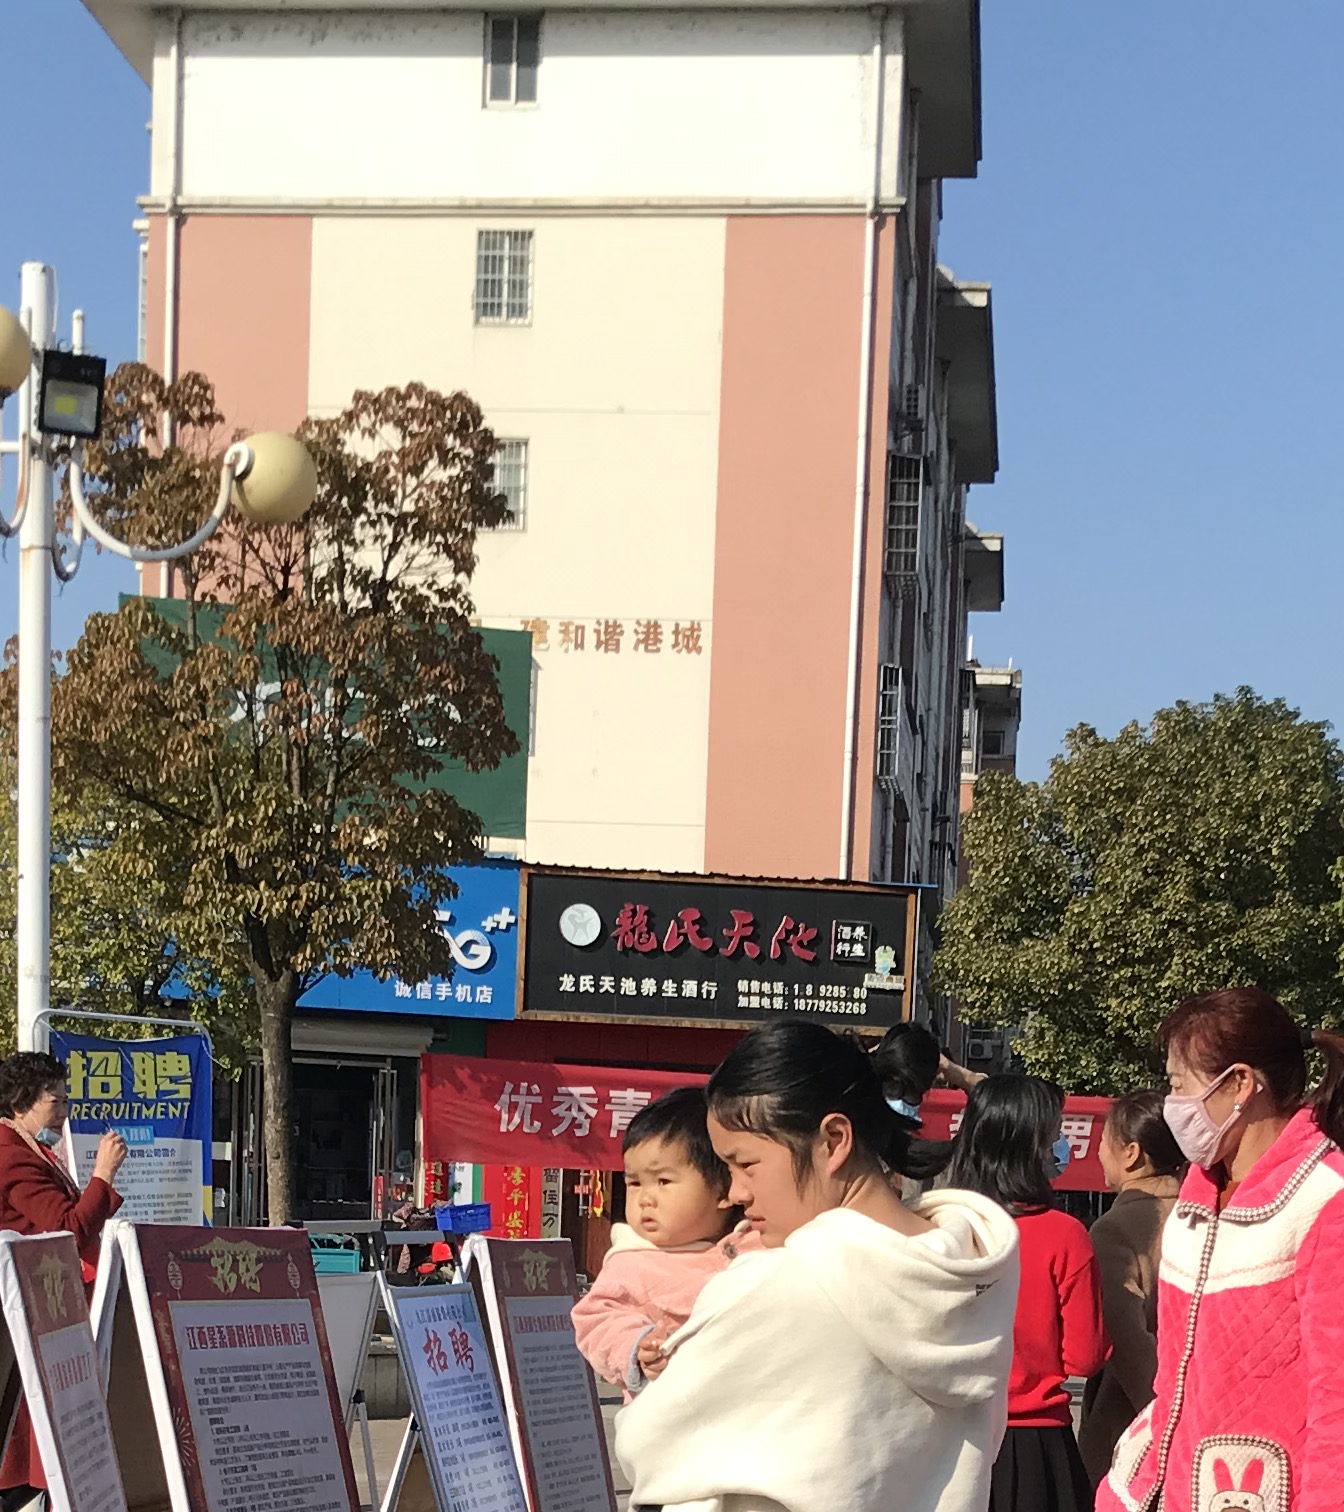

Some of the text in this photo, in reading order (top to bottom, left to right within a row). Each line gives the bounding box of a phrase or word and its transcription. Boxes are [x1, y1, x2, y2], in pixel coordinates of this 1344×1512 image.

[394, 980, 493, 1004] 诚信手机店
[559, 973, 718, 999] 龙氏天池养生酒行
[66, 1050, 193, 1100] 招聘
[70, 1102, 190, 1121] RECRUITMENT
[422, 1321, 474, 1375] 招聘
